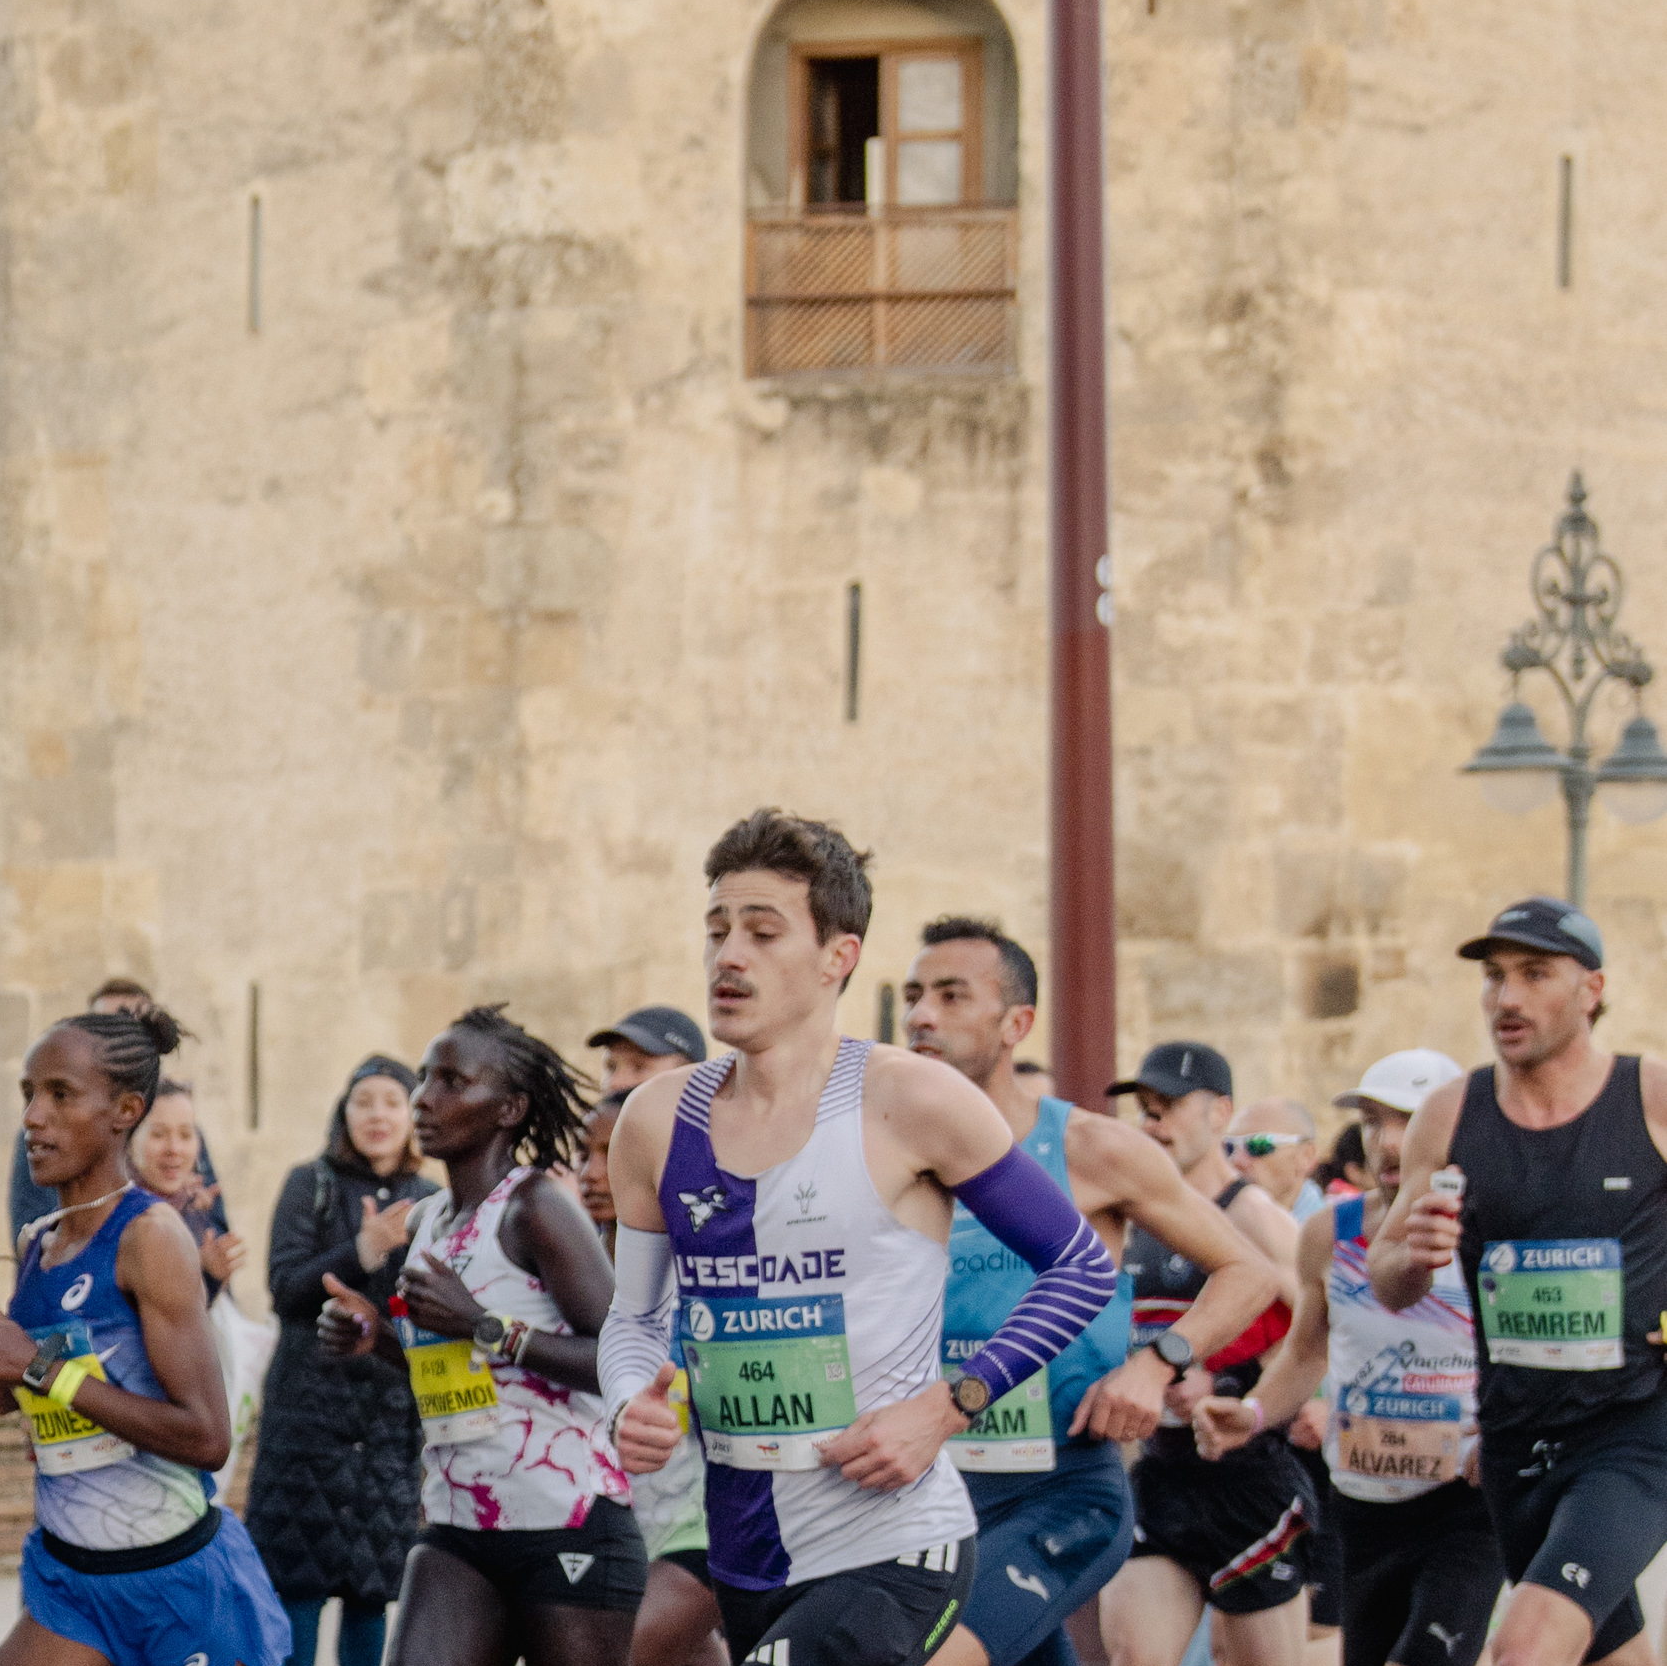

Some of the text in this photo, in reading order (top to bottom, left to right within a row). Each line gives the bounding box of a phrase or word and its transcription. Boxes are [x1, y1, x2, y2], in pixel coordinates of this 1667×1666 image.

[1522, 1247, 1604, 1269] ZURICH
[722, 1305, 823, 1333] ZURICH
[1496, 1310, 1606, 1336] REMREM
[739, 1360, 775, 1382] 464
[719, 1392, 815, 1427] ALLAN
[1374, 1397, 1446, 1418] ZURICH
